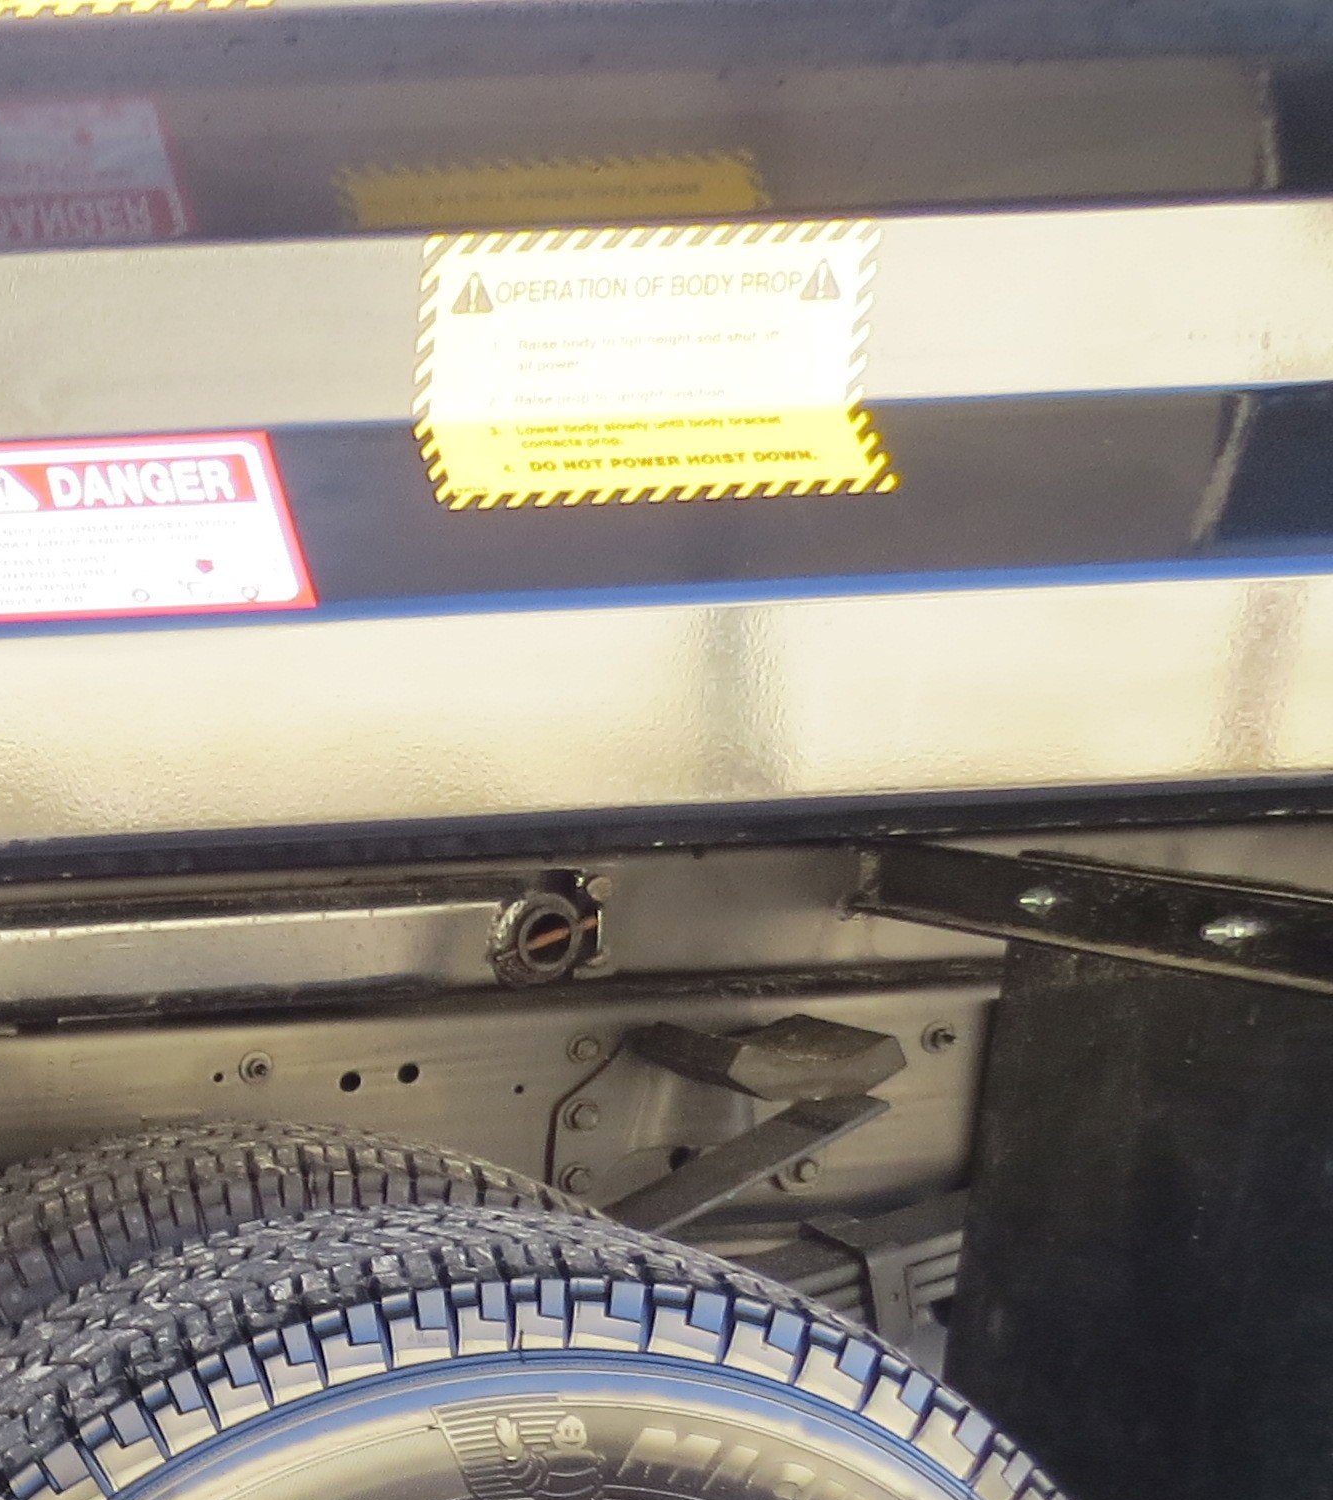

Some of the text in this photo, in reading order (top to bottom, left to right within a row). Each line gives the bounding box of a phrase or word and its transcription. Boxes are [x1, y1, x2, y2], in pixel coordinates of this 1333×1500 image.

[495, 269, 803, 304] OPERATION OF BODY PROP
[516, 423, 559, 436] Lower
[564, 422, 600, 436] body
[604, 420, 650, 435] slowly
[688, 416, 725, 431] body
[727, 414, 782, 427] bracket
[521, 437, 583, 449] contacts
[529, 459, 558, 473] DO
[563, 457, 603, 471] NOT
[609, 454, 682, 469] POWER
[686, 451, 746, 466] HOIST
[45, 458, 237, 511] DANGER
